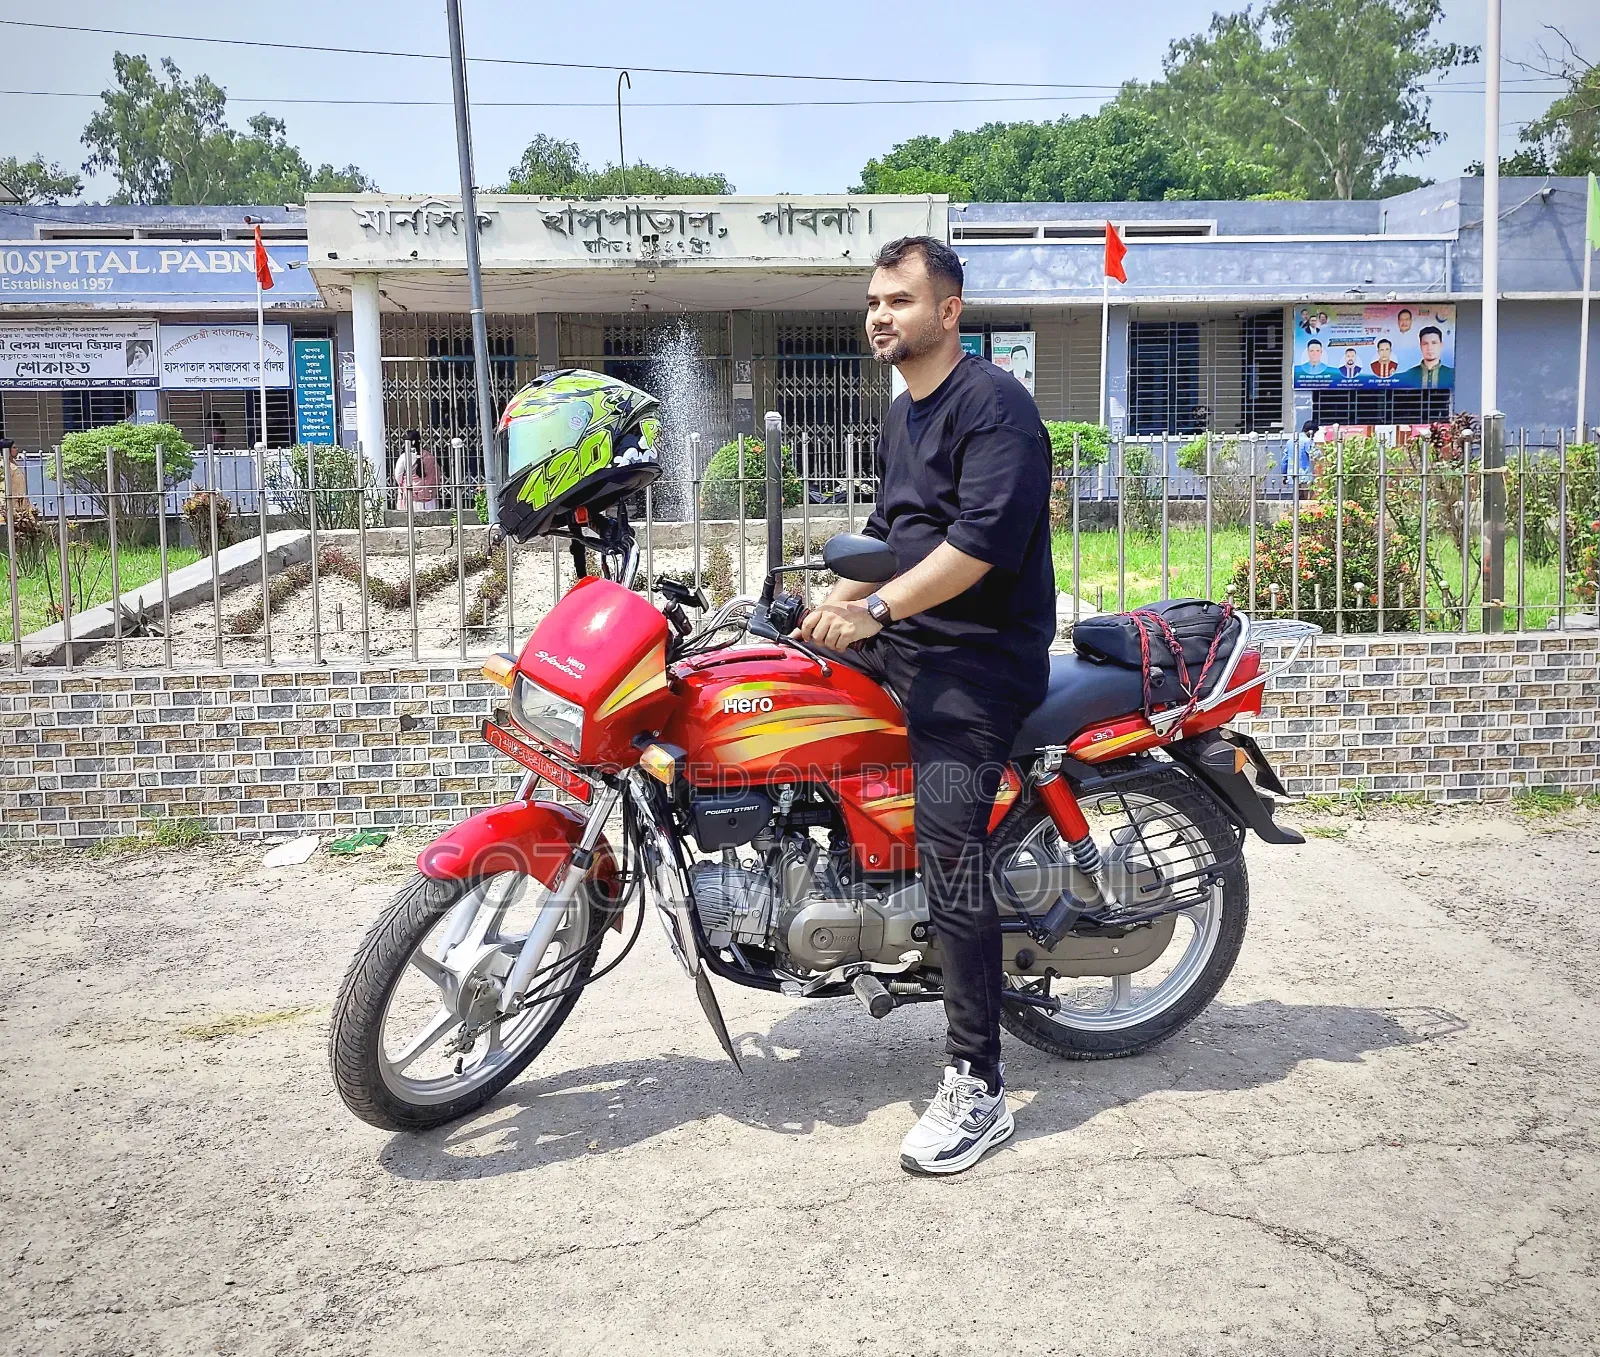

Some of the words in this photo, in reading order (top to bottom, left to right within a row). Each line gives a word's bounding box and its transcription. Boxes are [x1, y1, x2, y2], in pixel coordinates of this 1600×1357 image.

[2, 277, 79, 290] Established
[81, 277, 114, 290] 1957
[10, 341, 40, 351] বেগম
[44, 341, 83, 351] খালেদা
[16, 361, 91, 377] শোকাহত
[253, 358, 285, 373] কর্যালয়
[517, 429, 613, 512] 420
